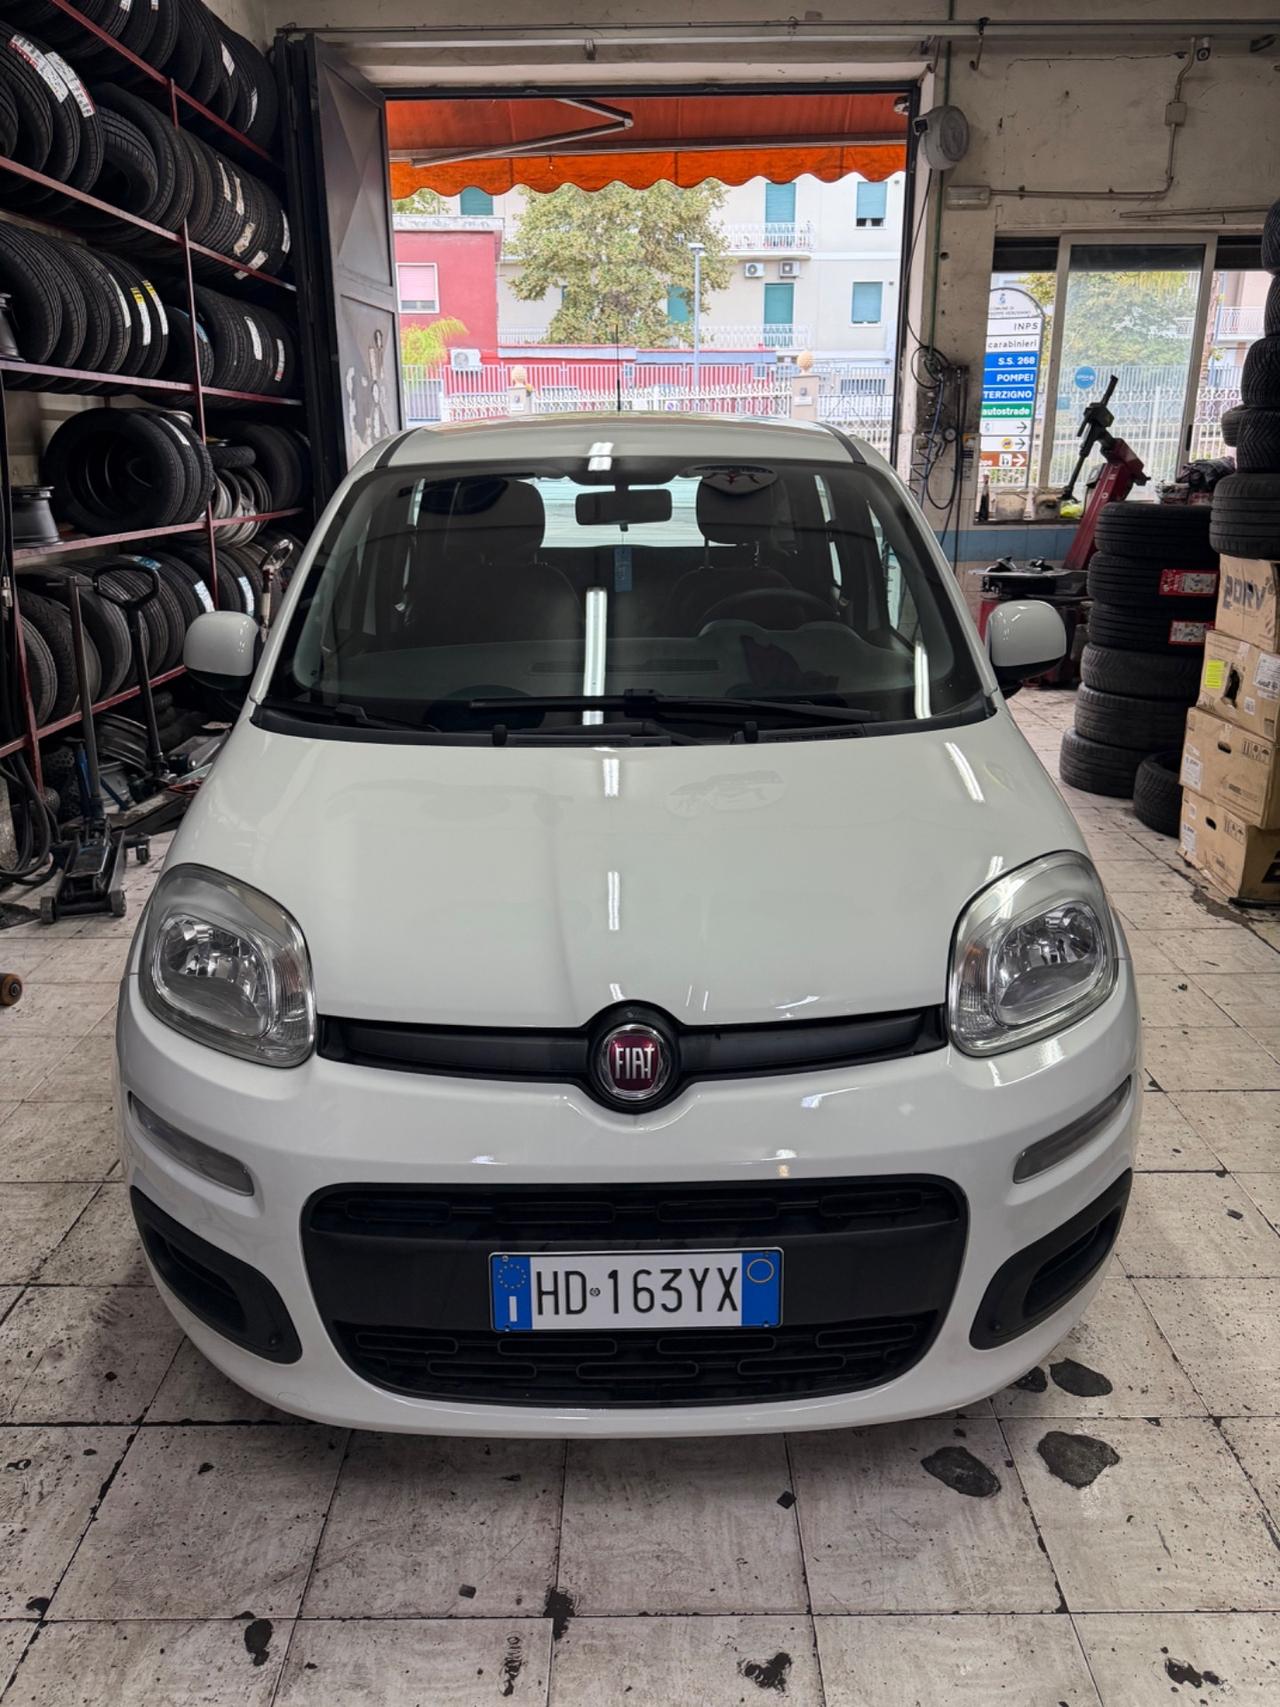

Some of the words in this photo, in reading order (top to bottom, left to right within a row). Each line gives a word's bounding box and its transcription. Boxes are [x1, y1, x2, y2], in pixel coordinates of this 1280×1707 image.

[1014, 322, 1038, 331] INPS
[988, 339, 1037, 348] carabinieri
[997, 357, 1015, 366] S.S.
[1017, 356, 1036, 365] 268
[996, 373, 1034, 382] POMPEI
[983, 390, 1033, 399] TERZIGNO
[982, 407, 1030, 416] autostrade
[614, 1045, 656, 1080] FIAT
[536, 1270, 588, 1316] HD
[607, 1267, 739, 1315] 163YX
